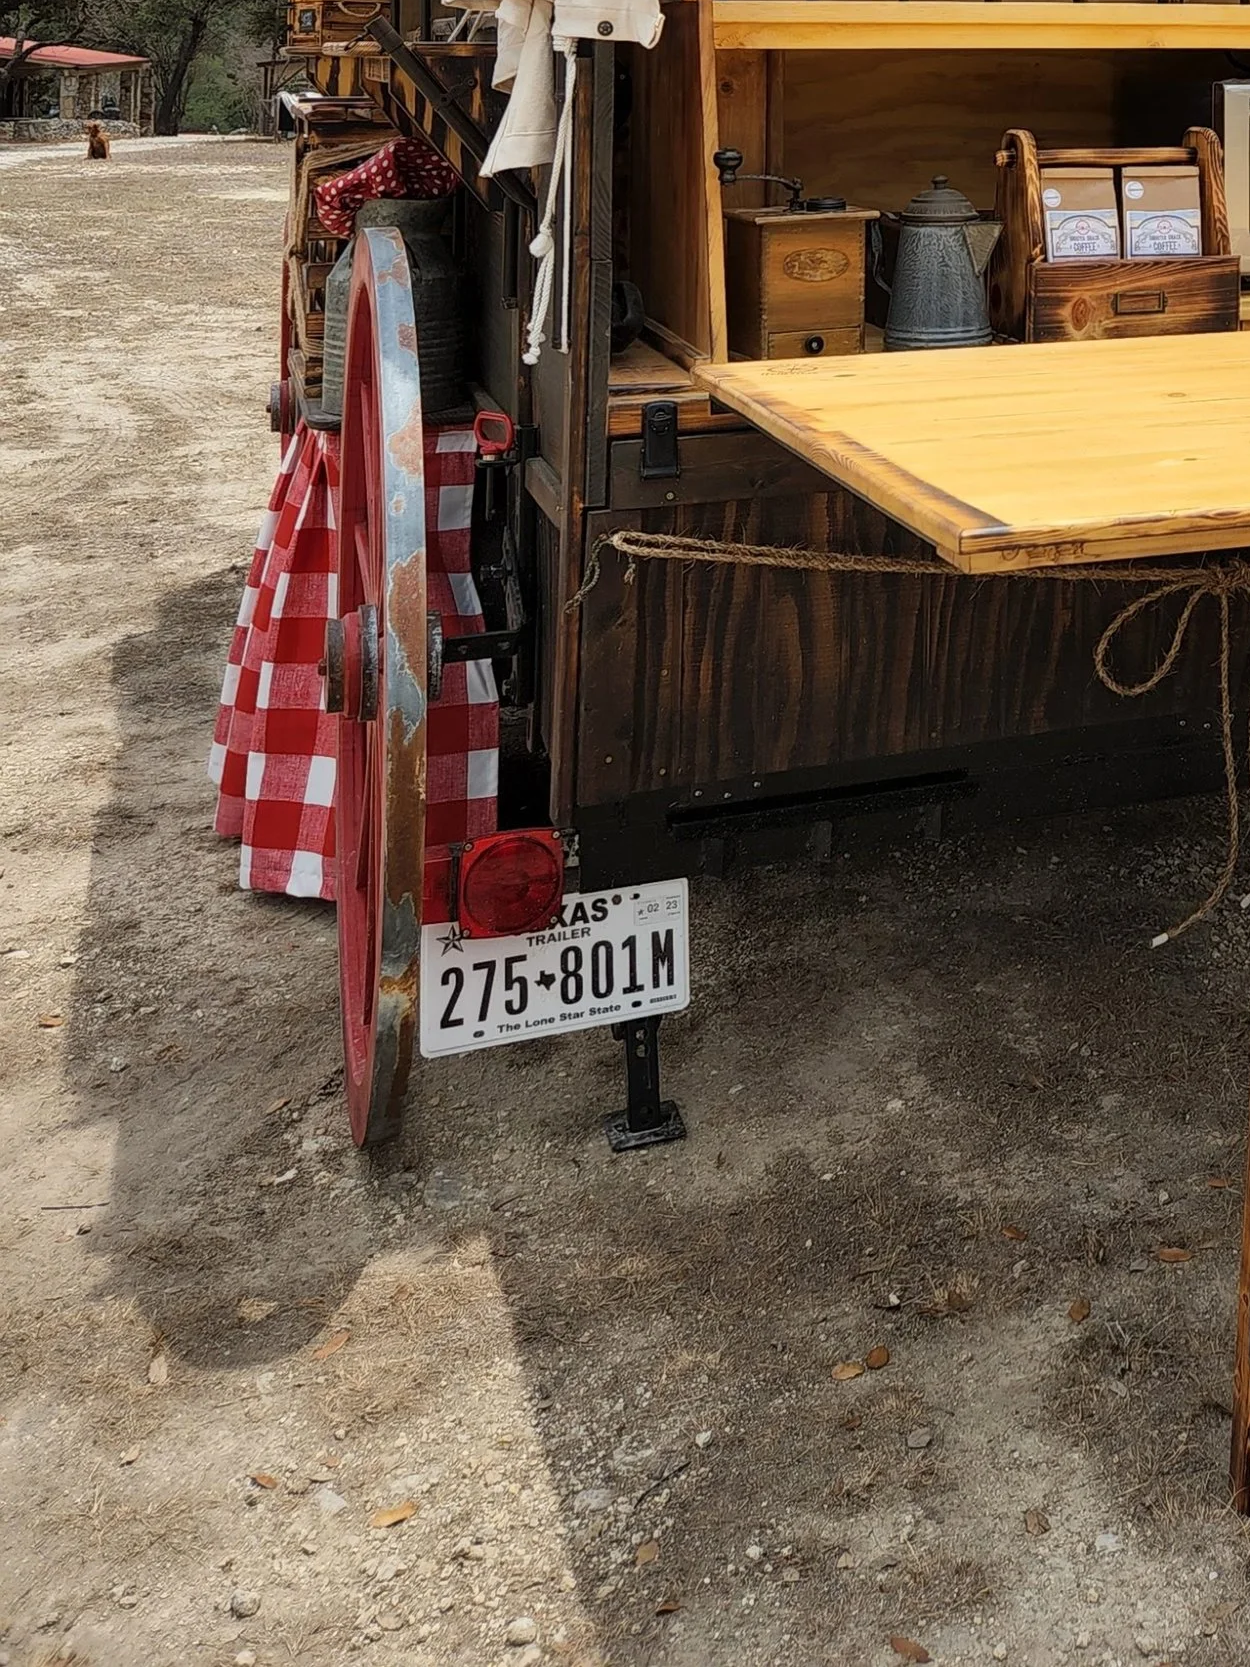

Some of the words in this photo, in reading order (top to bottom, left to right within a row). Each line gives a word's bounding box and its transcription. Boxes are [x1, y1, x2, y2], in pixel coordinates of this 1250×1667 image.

[1073, 242, 1097, 252] COFFEE
[1153, 241, 1177, 251] COFFEE
[547, 897, 609, 929] XAS
[647, 903, 660, 914] 02
[666, 900, 678, 910] 23
[526, 927, 592, 948] TRAILER
[497, 1022, 521, 1034] The
[525, 1015, 556, 1028] Lone
[559, 1010, 585, 1022] Star
[589, 1003, 622, 1017] State
